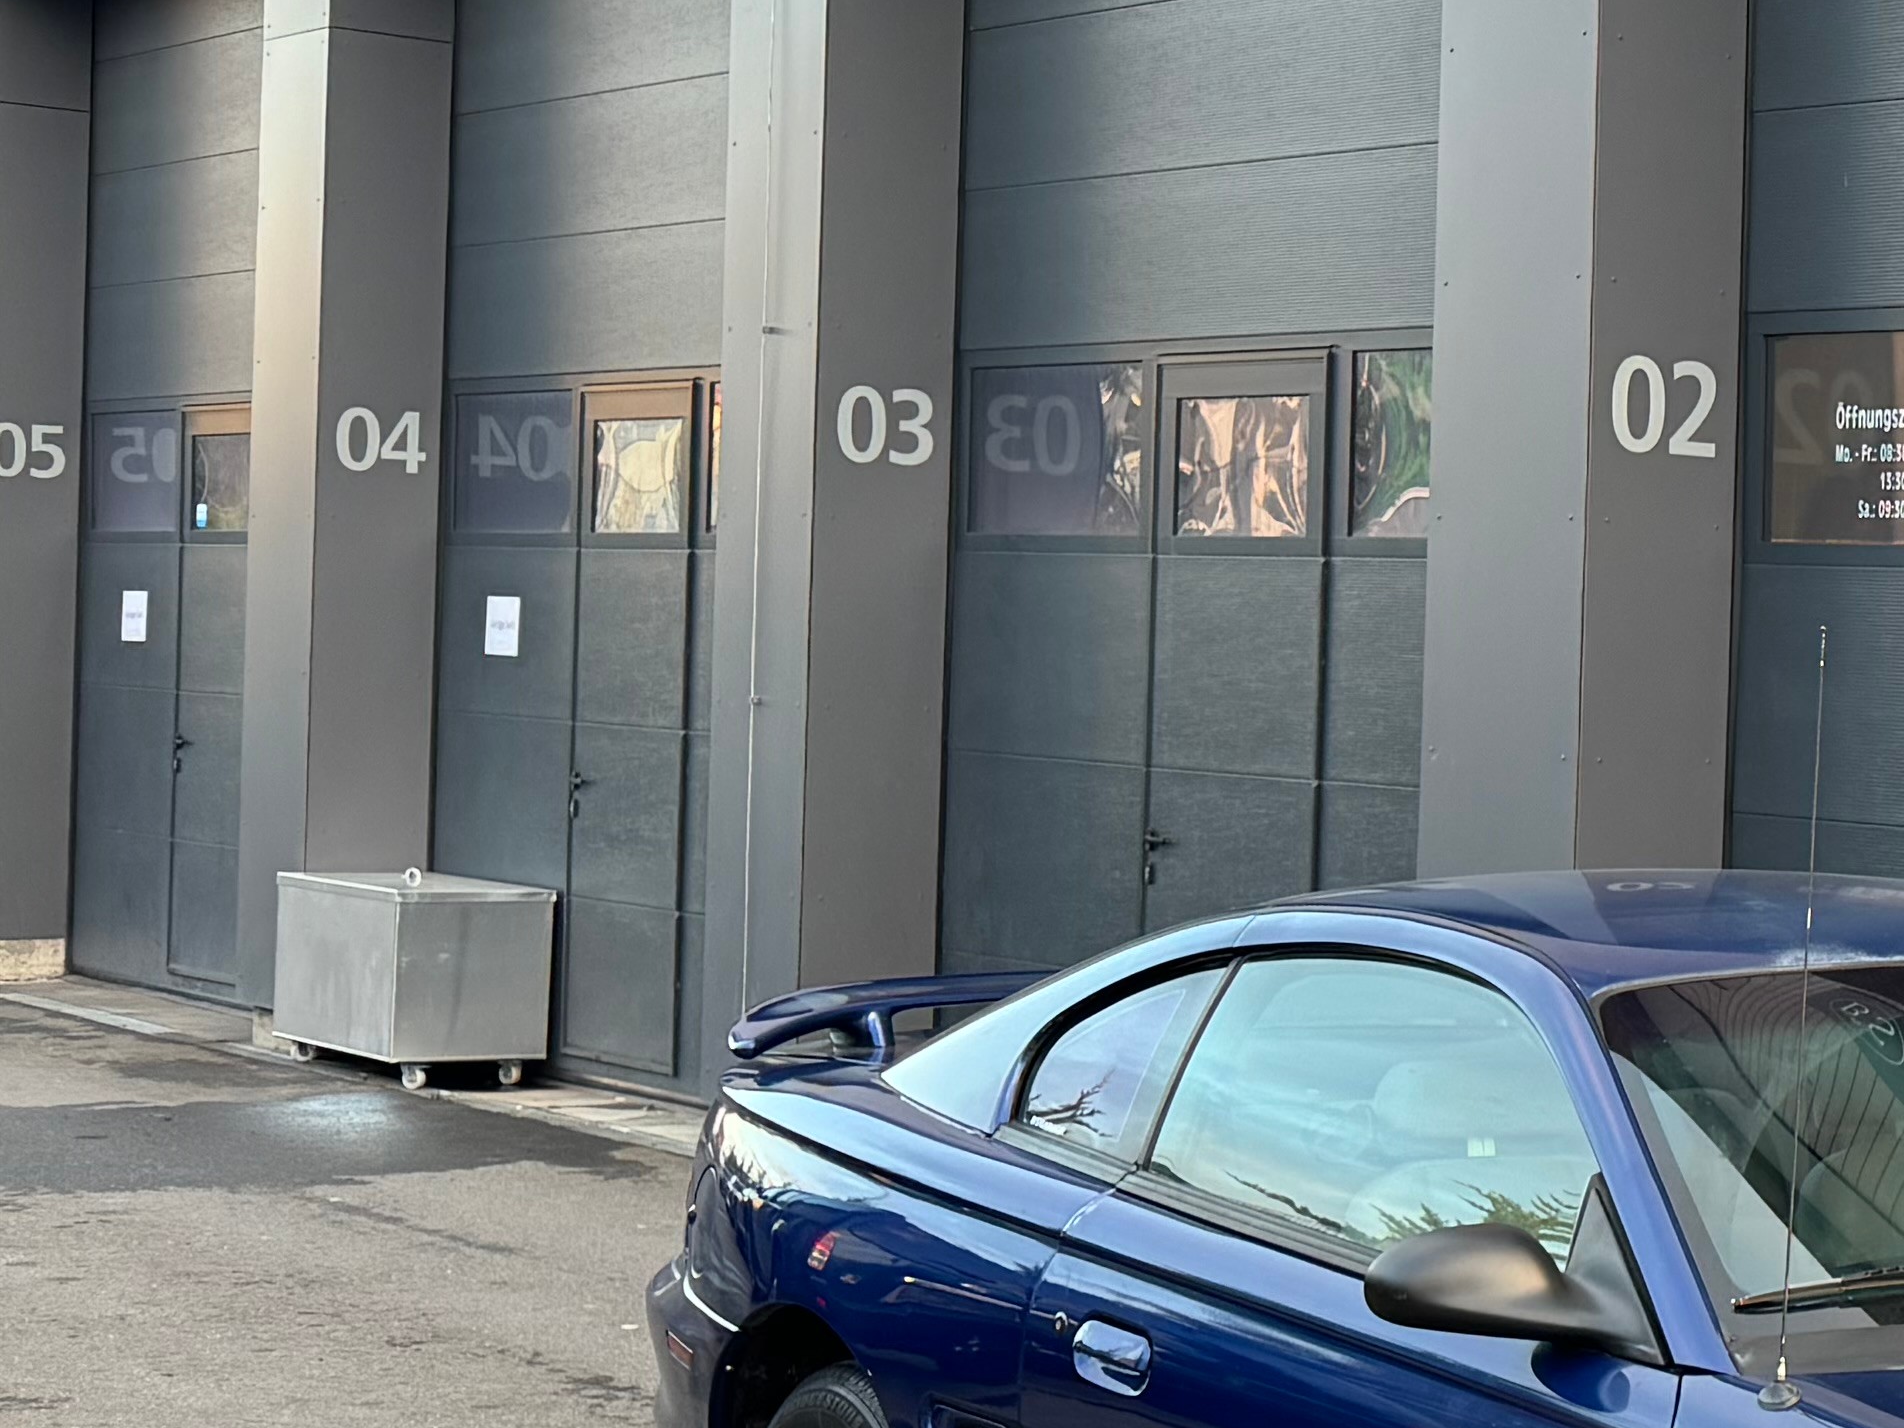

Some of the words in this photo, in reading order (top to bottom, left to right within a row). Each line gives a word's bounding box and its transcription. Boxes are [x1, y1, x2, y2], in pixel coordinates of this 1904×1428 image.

[335, 406, 427, 474] 04
[837, 385, 934, 466] 03
[1612, 354, 1717, 458] 02
[0, 422, 66, 479] 05
[1835, 444, 1853, 463] Mo.
